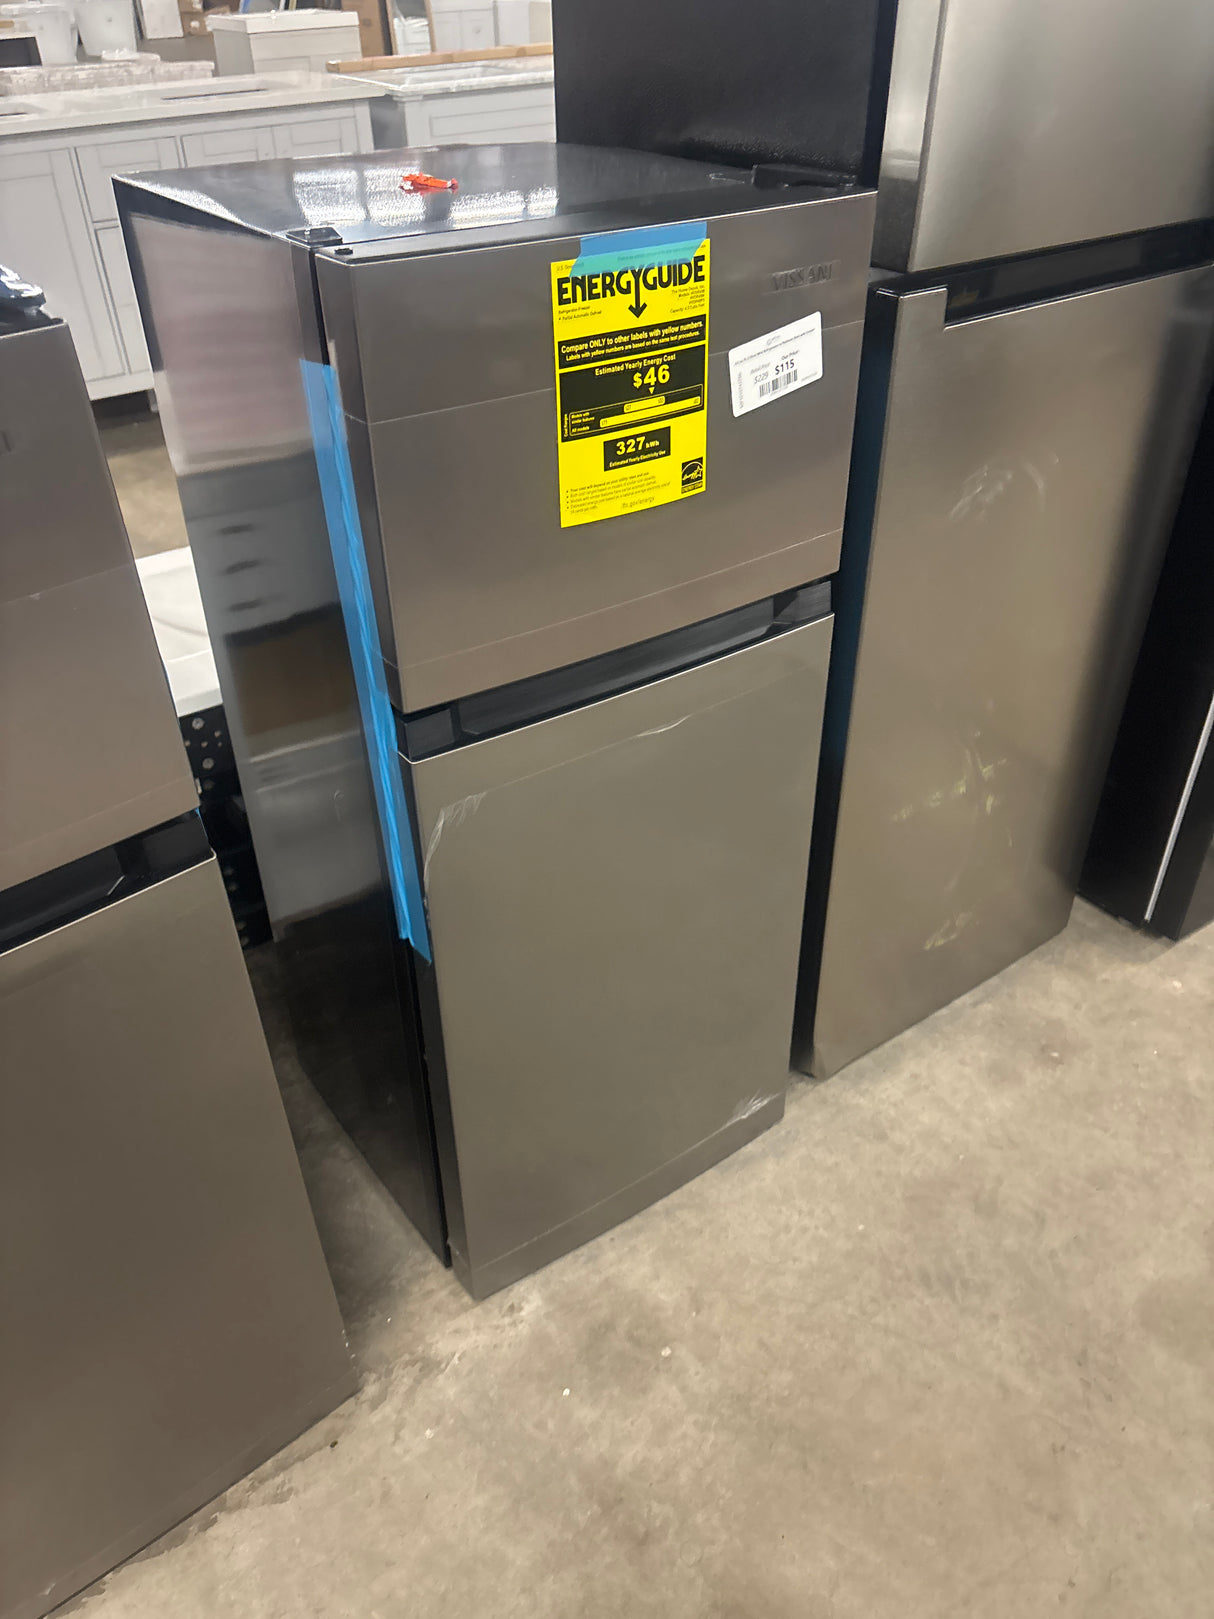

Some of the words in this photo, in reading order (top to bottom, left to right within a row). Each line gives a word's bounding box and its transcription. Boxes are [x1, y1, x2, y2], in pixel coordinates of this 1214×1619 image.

[557, 254, 705, 306] ENERGYGUIDE
[772, 263, 832, 291] VISSANI
[561, 343, 588, 354] Compare
[589, 338, 606, 349] ONLY
[614, 335, 630, 344] other
[630, 331, 648, 341] labels
[649, 328, 661, 337] with
[661, 326, 680, 337] yellow
[680, 321, 704, 331] numbers.
[566, 353, 581, 361] Labels
[590, 349, 605, 358] yellow
[605, 346, 624, 354] numbers
[632, 341, 645, 349] based
[595, 363, 625, 376] Estimated
[625, 361, 643, 370] Yearly
[643, 357, 662, 366] Energy
[663, 353, 676, 362] Cost
[775, 358, 795, 375] $115
[633, 364, 670, 389] $46
[616, 436, 646, 455] 327
[646, 440, 660, 449] kWh
[609, 458, 629, 468] Estimated
[629, 455, 640, 464] Yearly
[640, 451, 659, 461] Electricity
